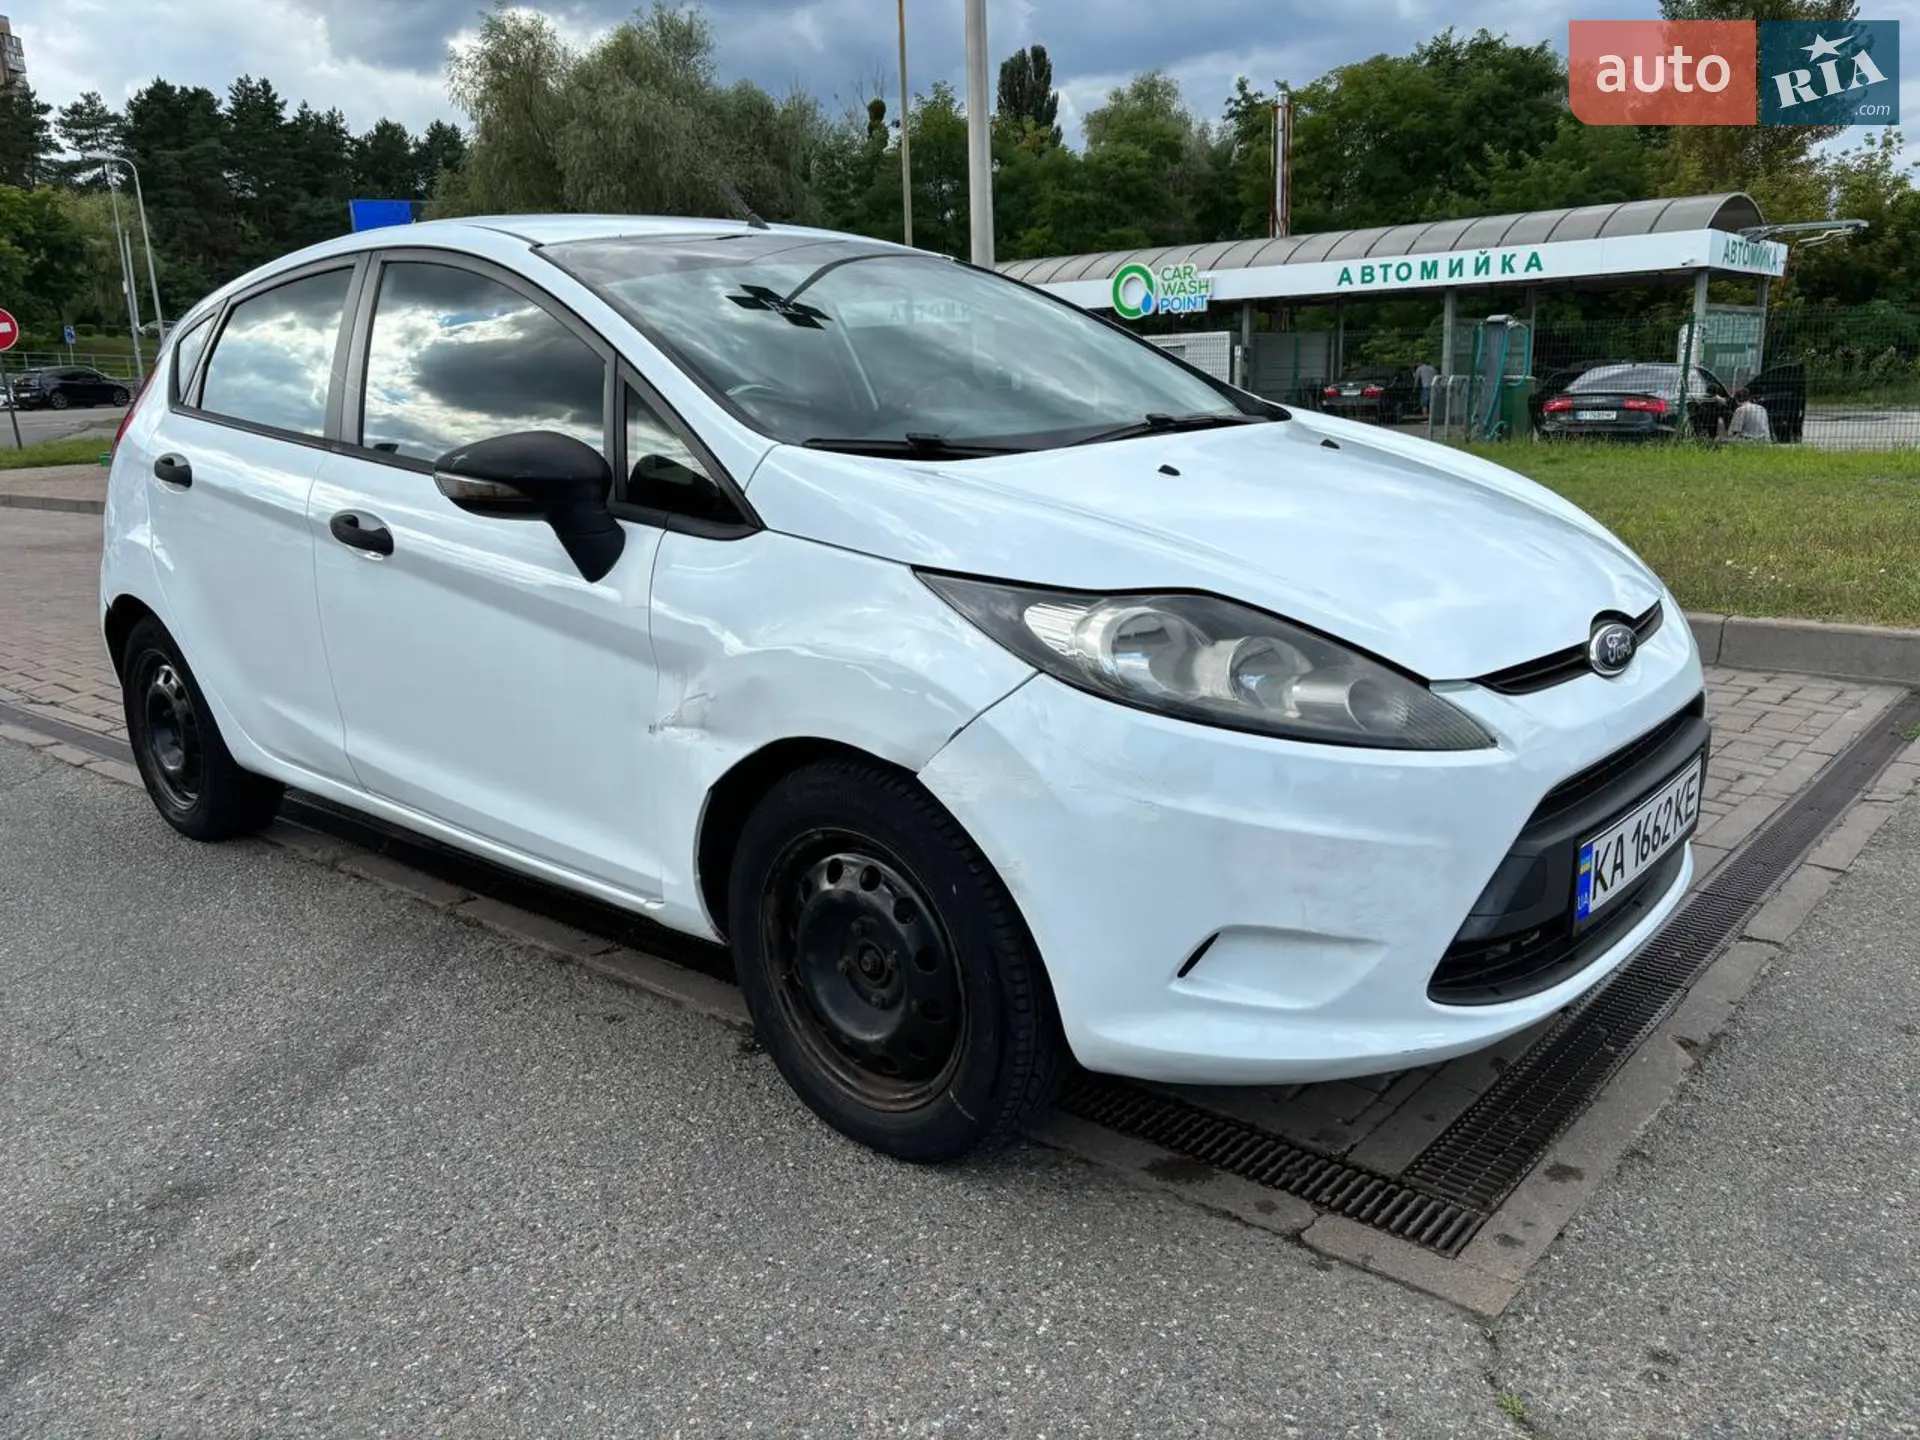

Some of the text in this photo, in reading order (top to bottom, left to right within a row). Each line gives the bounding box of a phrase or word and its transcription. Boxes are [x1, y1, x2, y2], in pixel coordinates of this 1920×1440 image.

[1161, 265, 1194, 281] CAR
[1337, 250, 1543, 286] АВТОМИЙКА
[1162, 279, 1210, 296] WASH
[1160, 295, 1207, 313] POINT
[1605, 631, 1632, 663] Ford
[1592, 833, 1625, 901] KA
